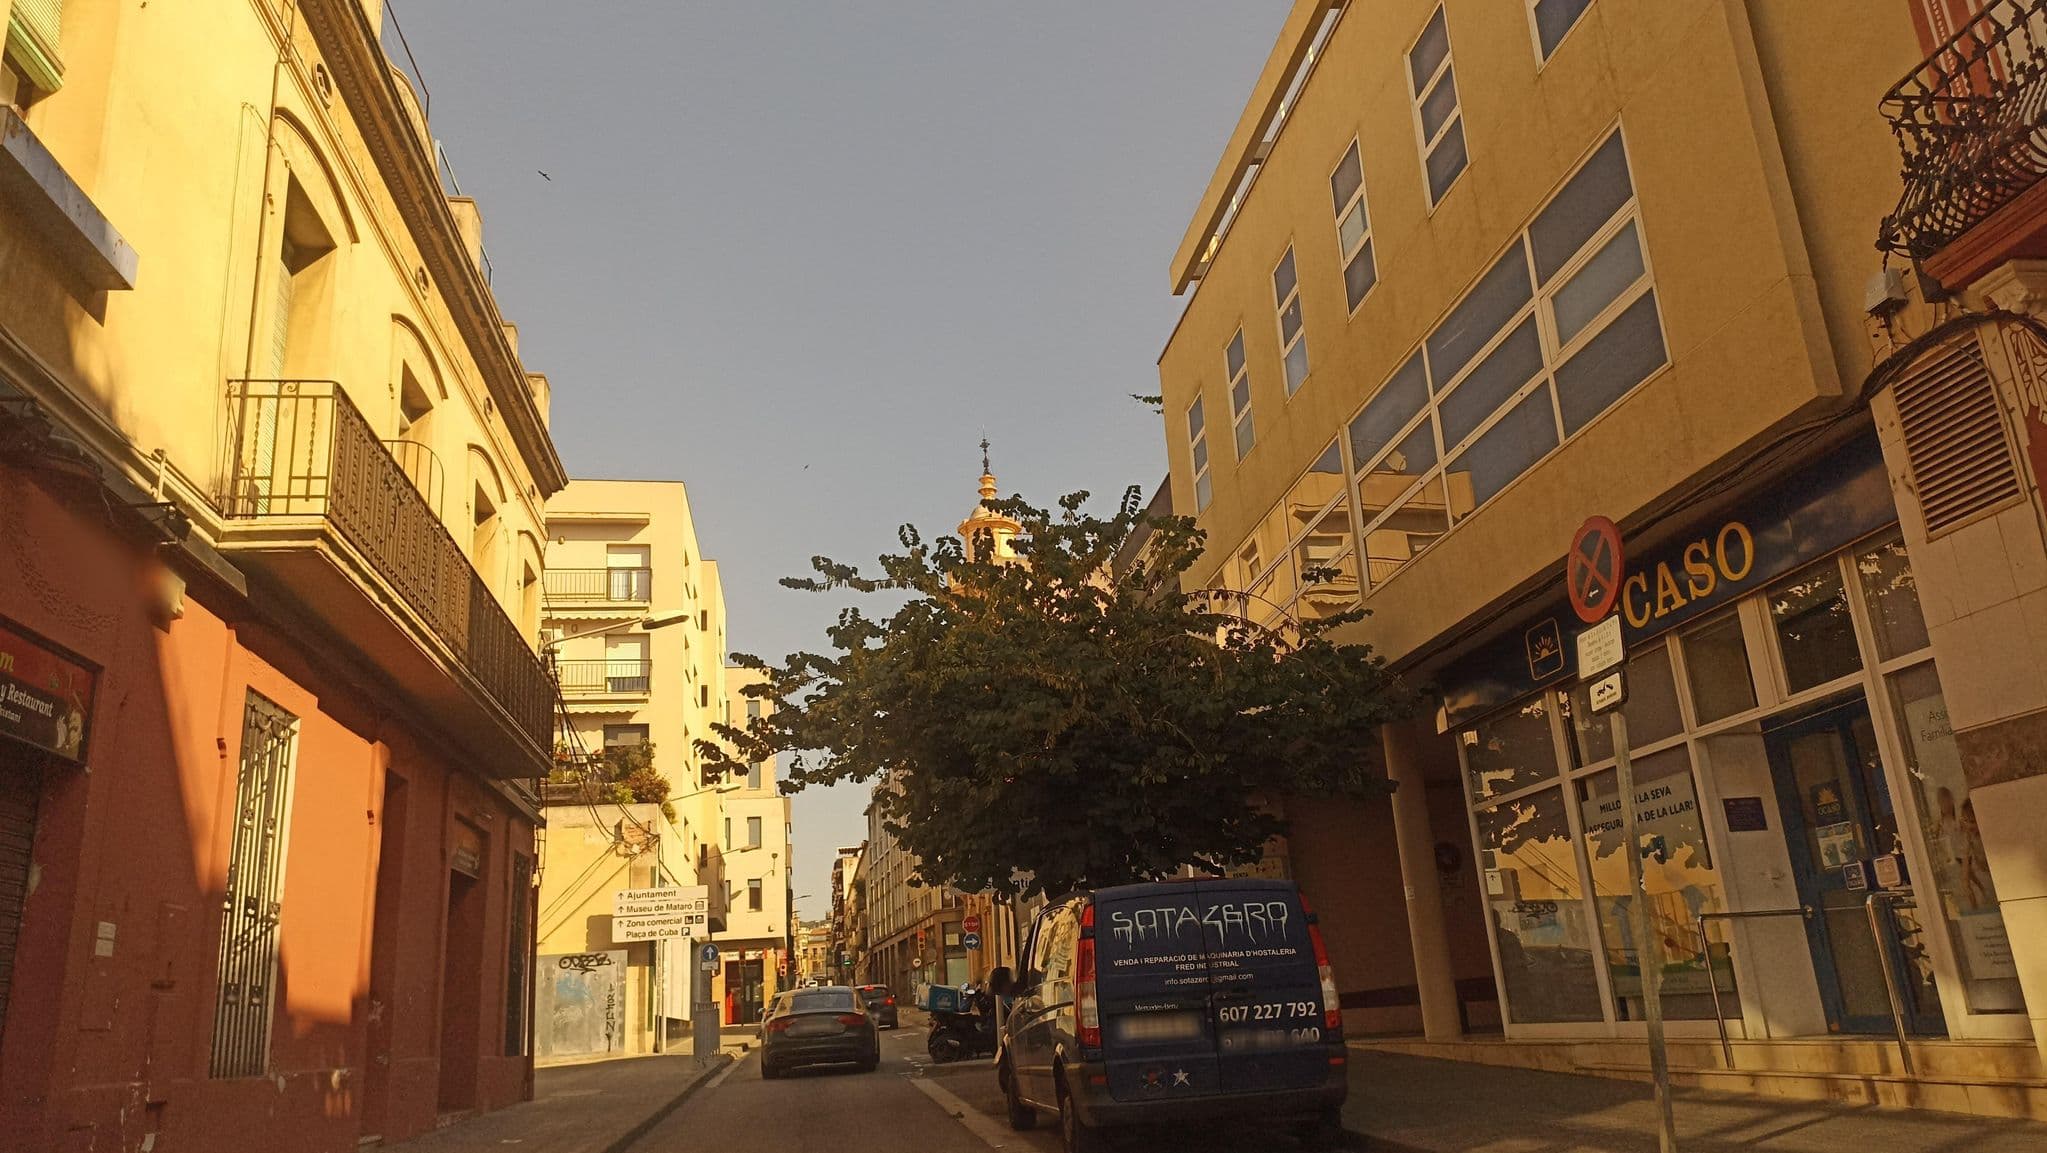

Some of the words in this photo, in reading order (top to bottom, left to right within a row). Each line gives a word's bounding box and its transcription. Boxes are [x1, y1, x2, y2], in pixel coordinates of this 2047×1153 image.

[1613, 522, 1755, 629] CASO
[8, 683, 53, 718] Restaurant
[1638, 792, 1650, 803] LA
[1650, 785, 1672, 800] SEVA
[1645, 811, 1656, 822] DE
[1656, 807, 1669, 818] LA
[1669, 800, 1694, 815] LLAR!
[627, 890, 677, 900] Ajuntament
[666, 903, 693, 911] Mataró
[626, 919, 645, 927] Zona
[647, 917, 682, 926] comercial
[626, 930, 646, 938] Plaça
[1113, 958, 1139, 967] VENDA
[1143, 955, 1187, 964] REPARACIÓ
[1187, 954, 1198, 962] DE
[1245, 948, 1297, 958] D'HOSTALERIA
[1175, 963, 1195, 971] FRED
[1219, 1006, 1249, 1022] 607
[1253, 1004, 1282, 1020] 227
[1286, 1001, 1317, 1018] 792
